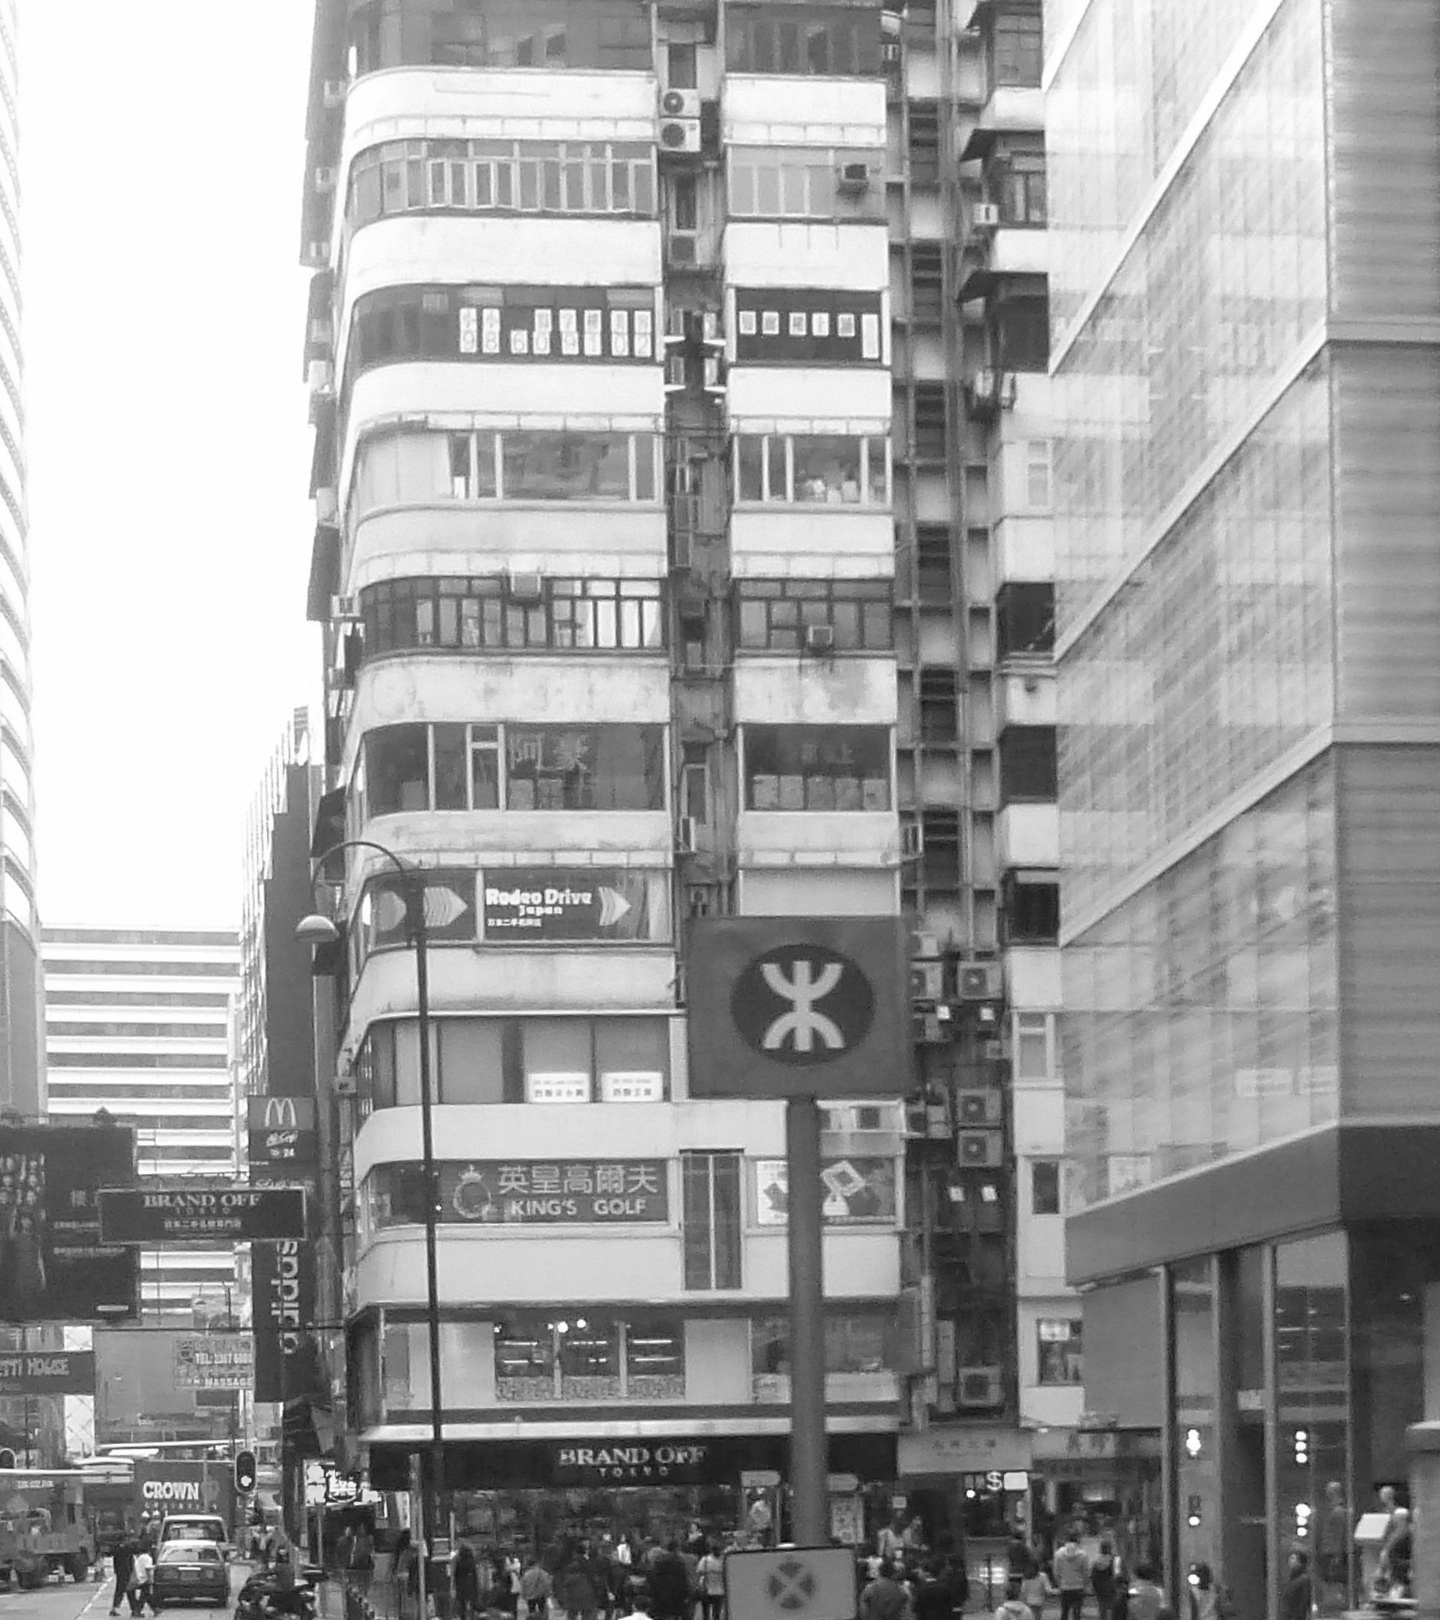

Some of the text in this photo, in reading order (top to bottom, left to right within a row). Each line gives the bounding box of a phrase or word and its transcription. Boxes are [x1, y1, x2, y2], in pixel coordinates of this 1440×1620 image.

[485, 888, 593, 906] Rodeo Drive
[498, 1164, 659, 1194] 英皇高爾夫
[143, 1192, 262, 1209] BRAND OFF
[511, 1198, 647, 1216] KING'S GOLF
[26, 1357, 71, 1377] HOUSE
[559, 1446, 707, 1466] BRAND OFF
[142, 1480, 200, 1500] CROWN
